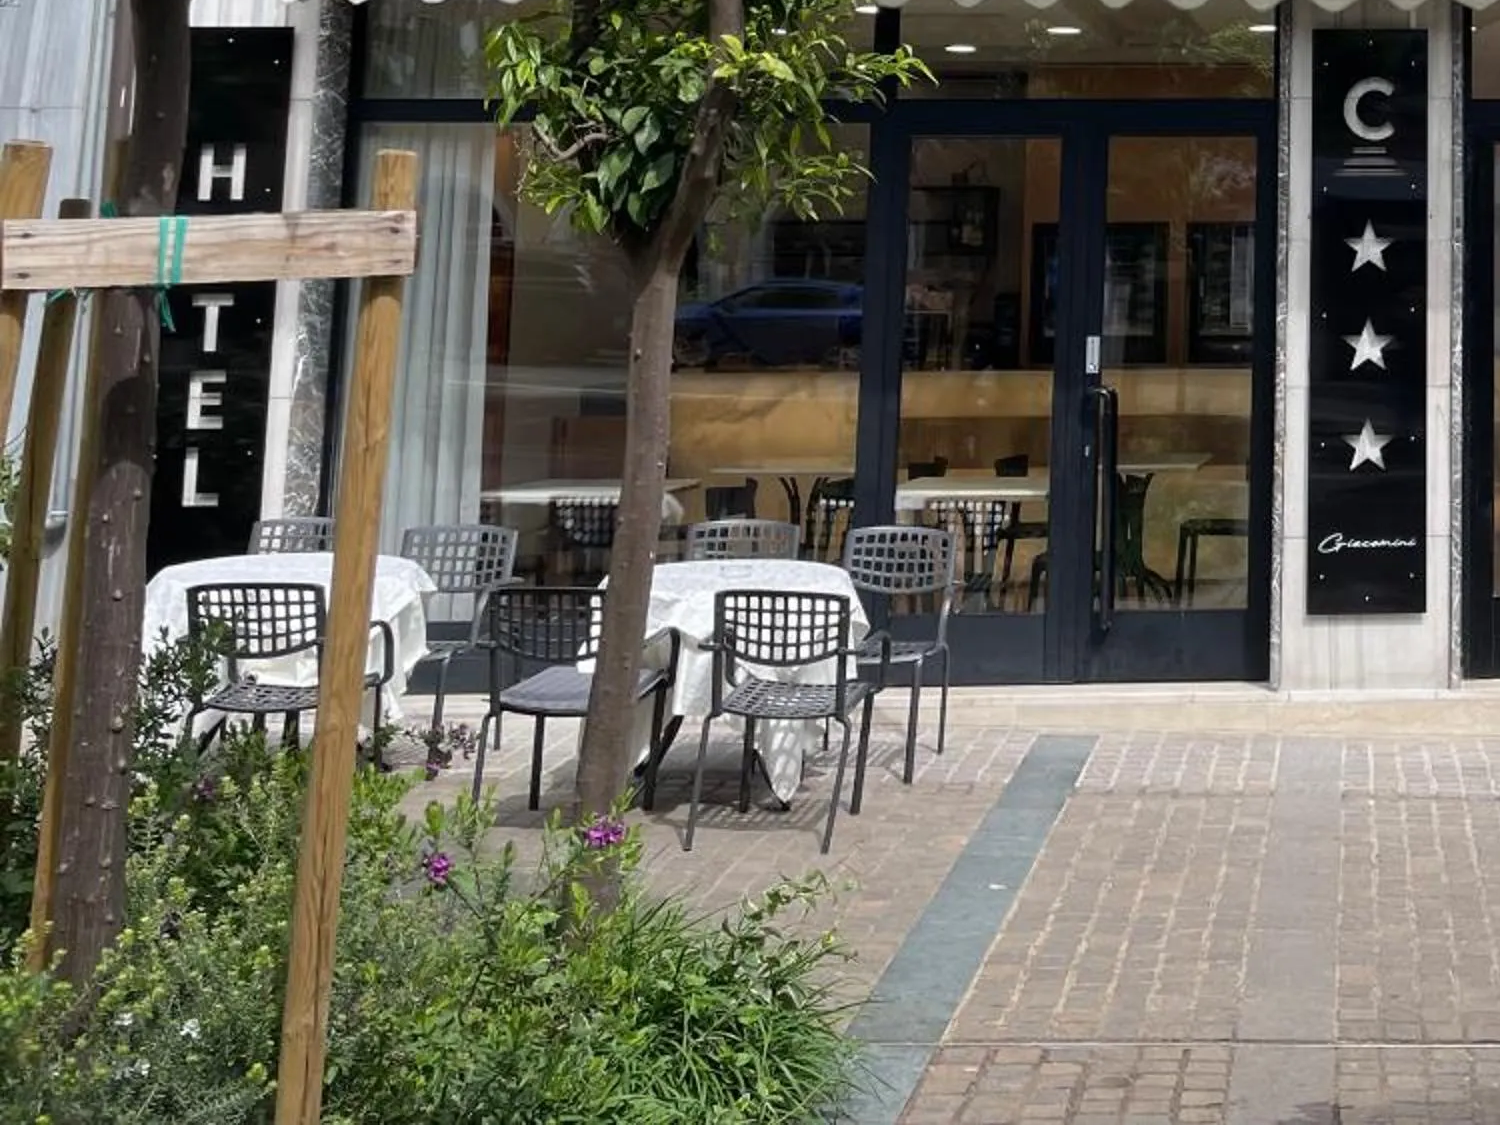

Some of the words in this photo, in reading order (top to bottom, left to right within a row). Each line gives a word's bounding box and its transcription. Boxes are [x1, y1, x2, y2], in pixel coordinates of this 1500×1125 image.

[1343, 76, 1396, 141] C
[181, 143, 248, 508] HTEL
[1318, 533, 1417, 554] Giacomini
